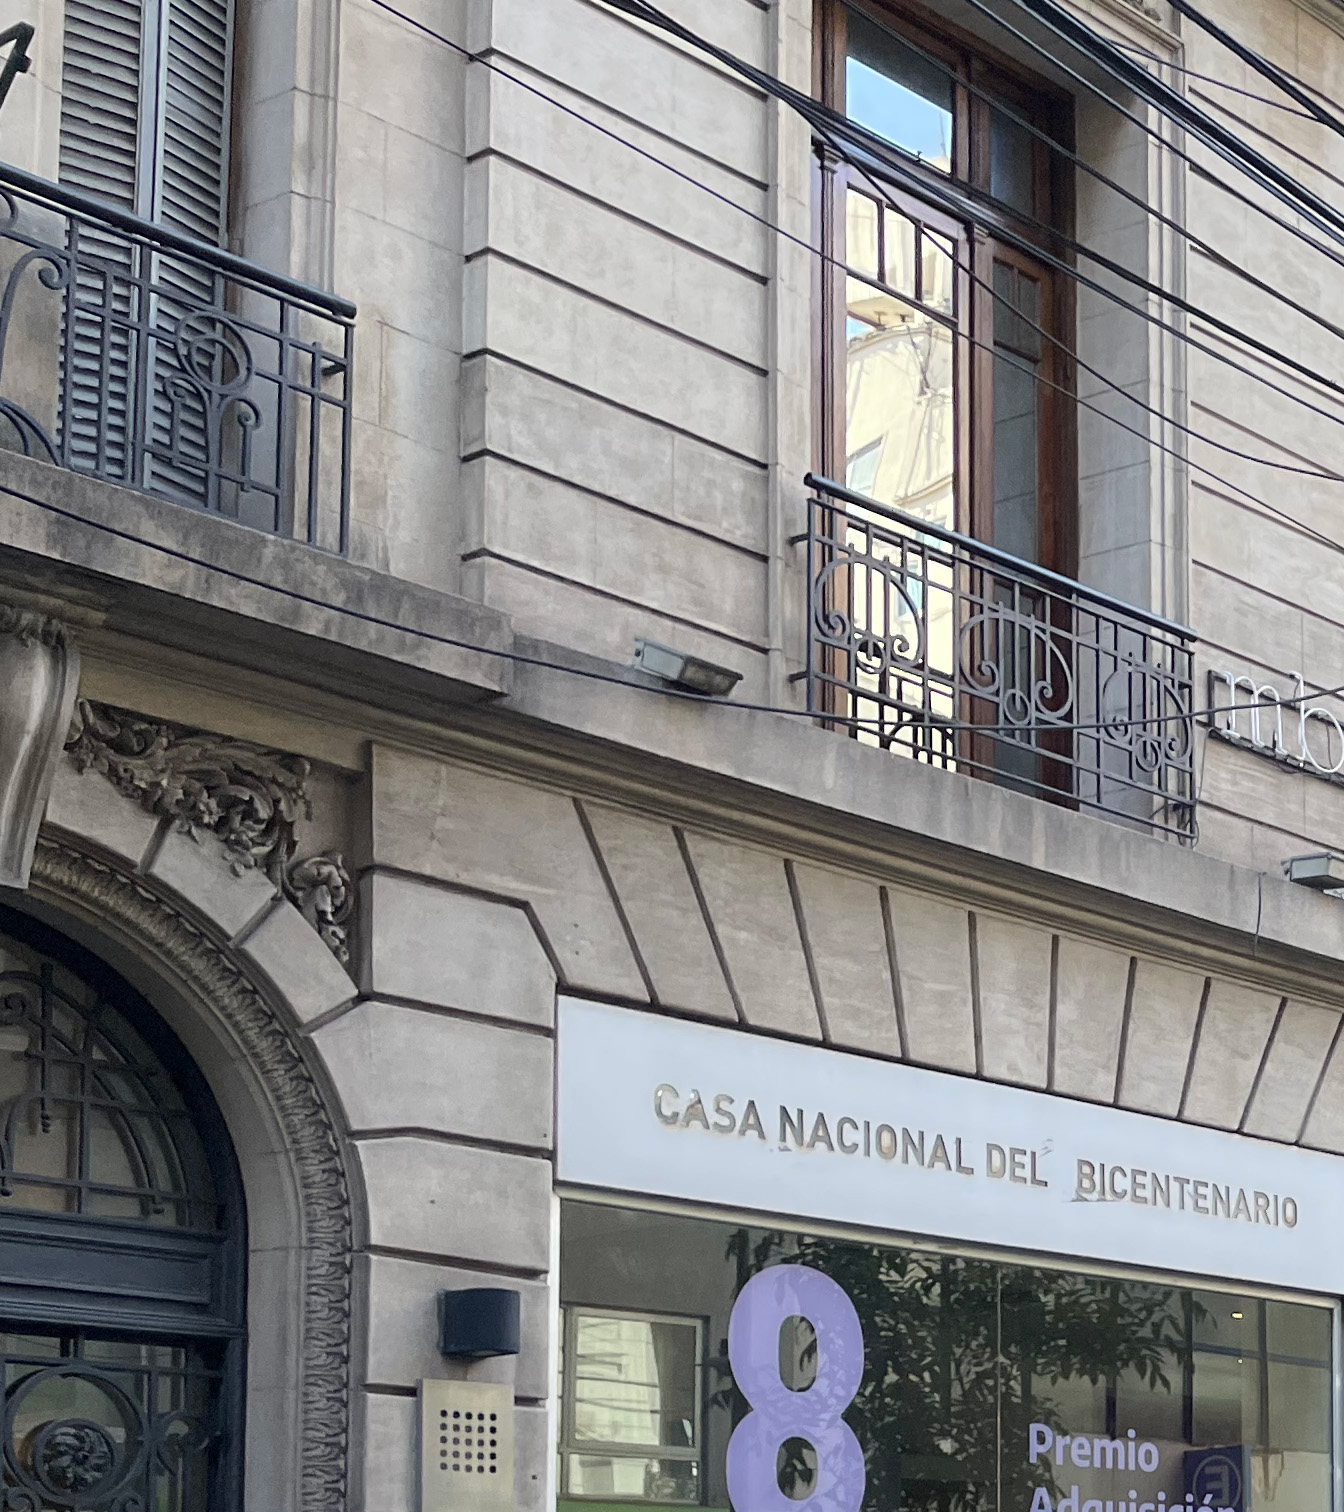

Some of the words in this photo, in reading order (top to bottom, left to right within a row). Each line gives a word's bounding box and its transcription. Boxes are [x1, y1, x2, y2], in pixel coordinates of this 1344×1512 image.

[654, 1083, 766, 1140] CASA
[779, 1104, 975, 1175] NACIONAL
[986, 1142, 1049, 1188] DEL
[1076, 1158, 1298, 1229] BICENTENARIO
[1028, 1422, 1160, 1473] Premio
